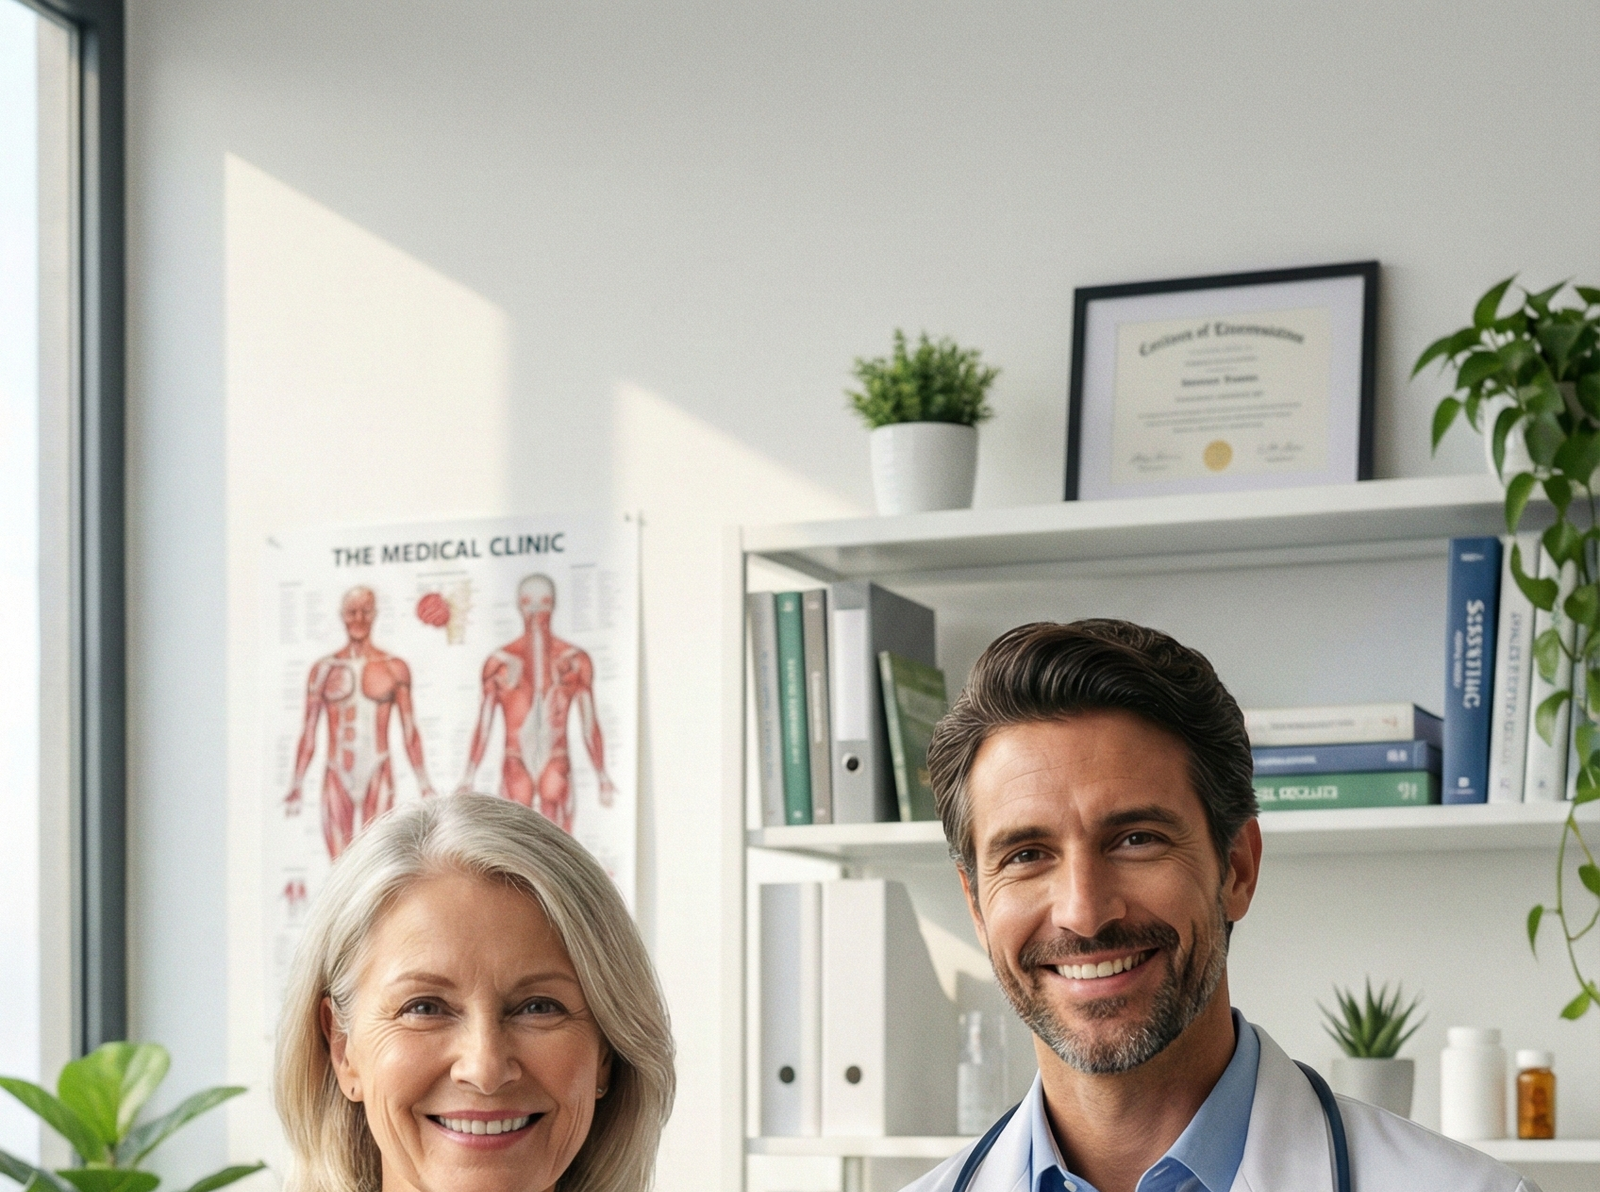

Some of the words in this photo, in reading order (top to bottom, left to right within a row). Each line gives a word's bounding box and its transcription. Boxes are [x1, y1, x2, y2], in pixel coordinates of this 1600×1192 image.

[333, 547, 373, 566] THE
[381, 540, 480, 563] MEDICAL
[490, 533, 564, 556] CLINIC
